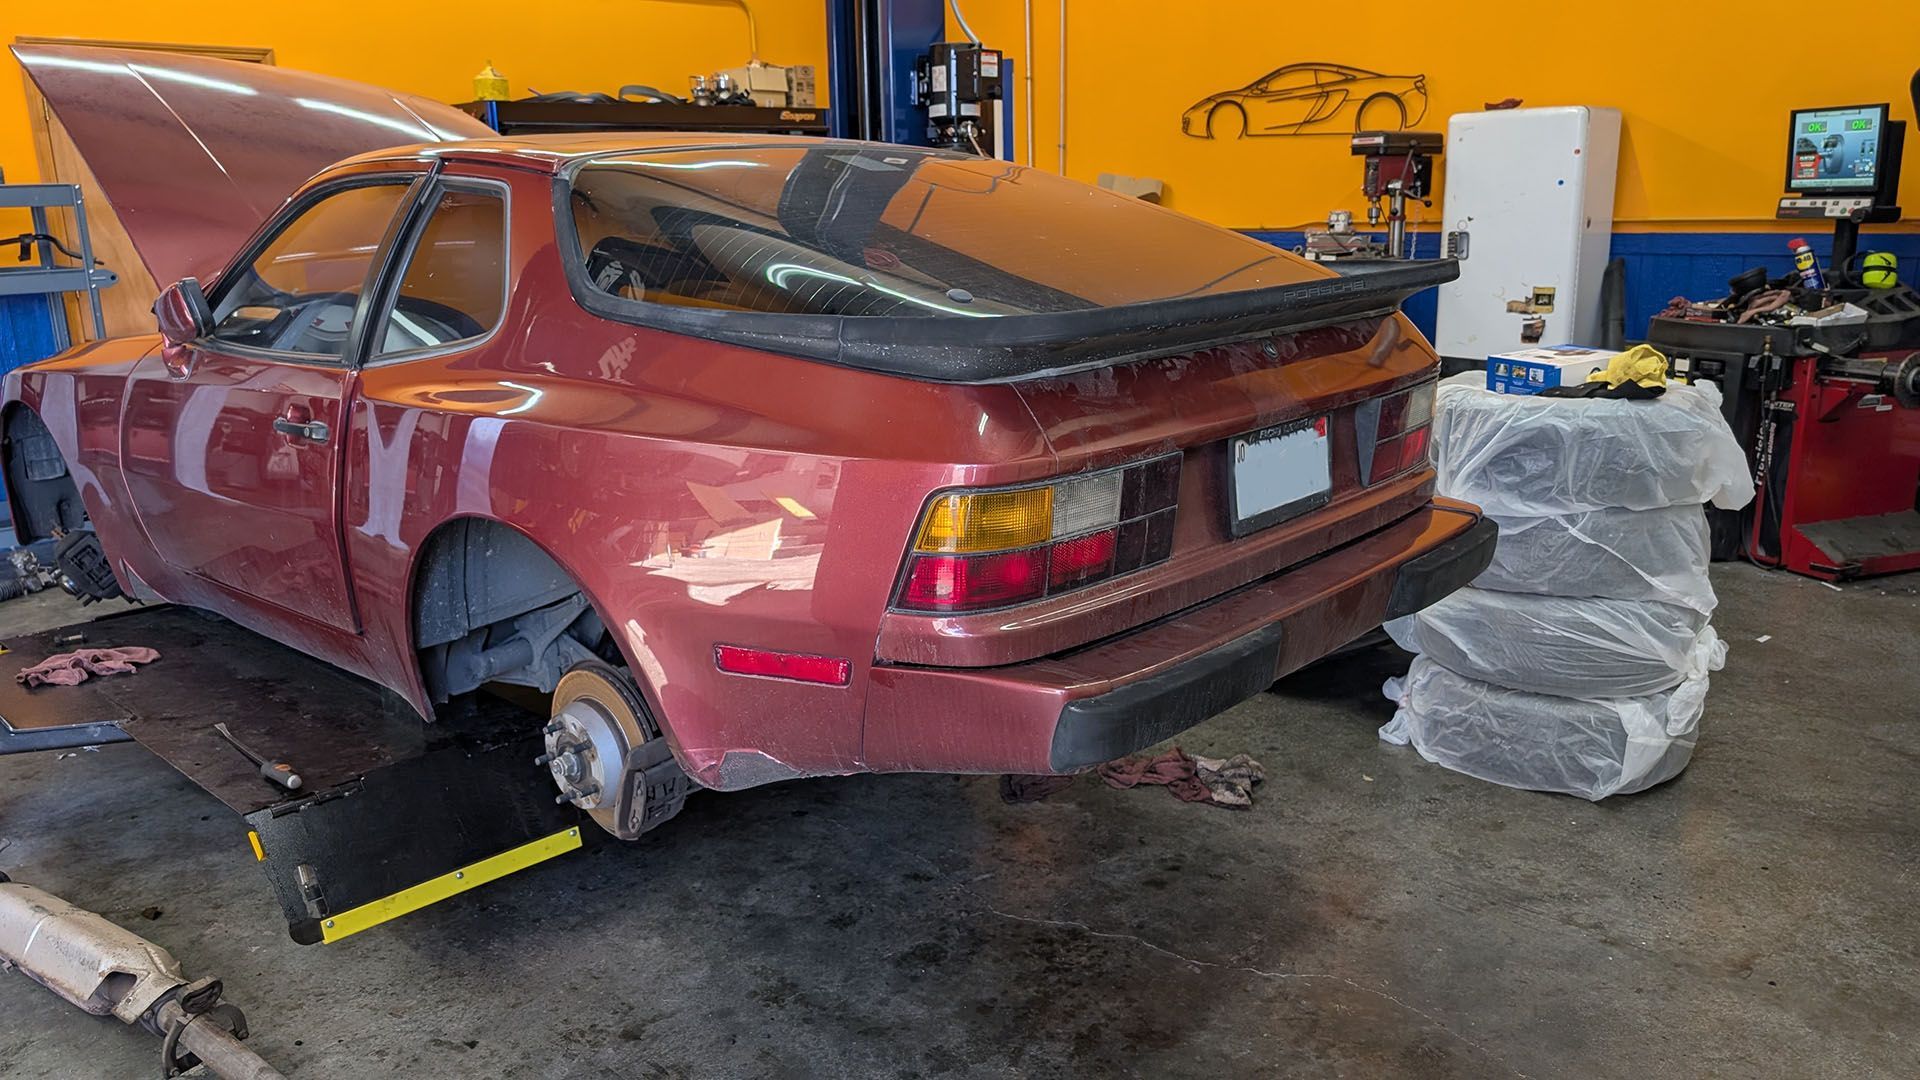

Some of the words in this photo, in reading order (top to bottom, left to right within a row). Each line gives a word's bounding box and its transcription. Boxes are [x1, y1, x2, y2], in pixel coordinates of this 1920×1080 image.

[1808, 122, 1821, 134] OK
[1852, 118, 1866, 129] OK
[1283, 280, 1365, 301] PORSCHE
[1764, 399, 1794, 408] HNTER
